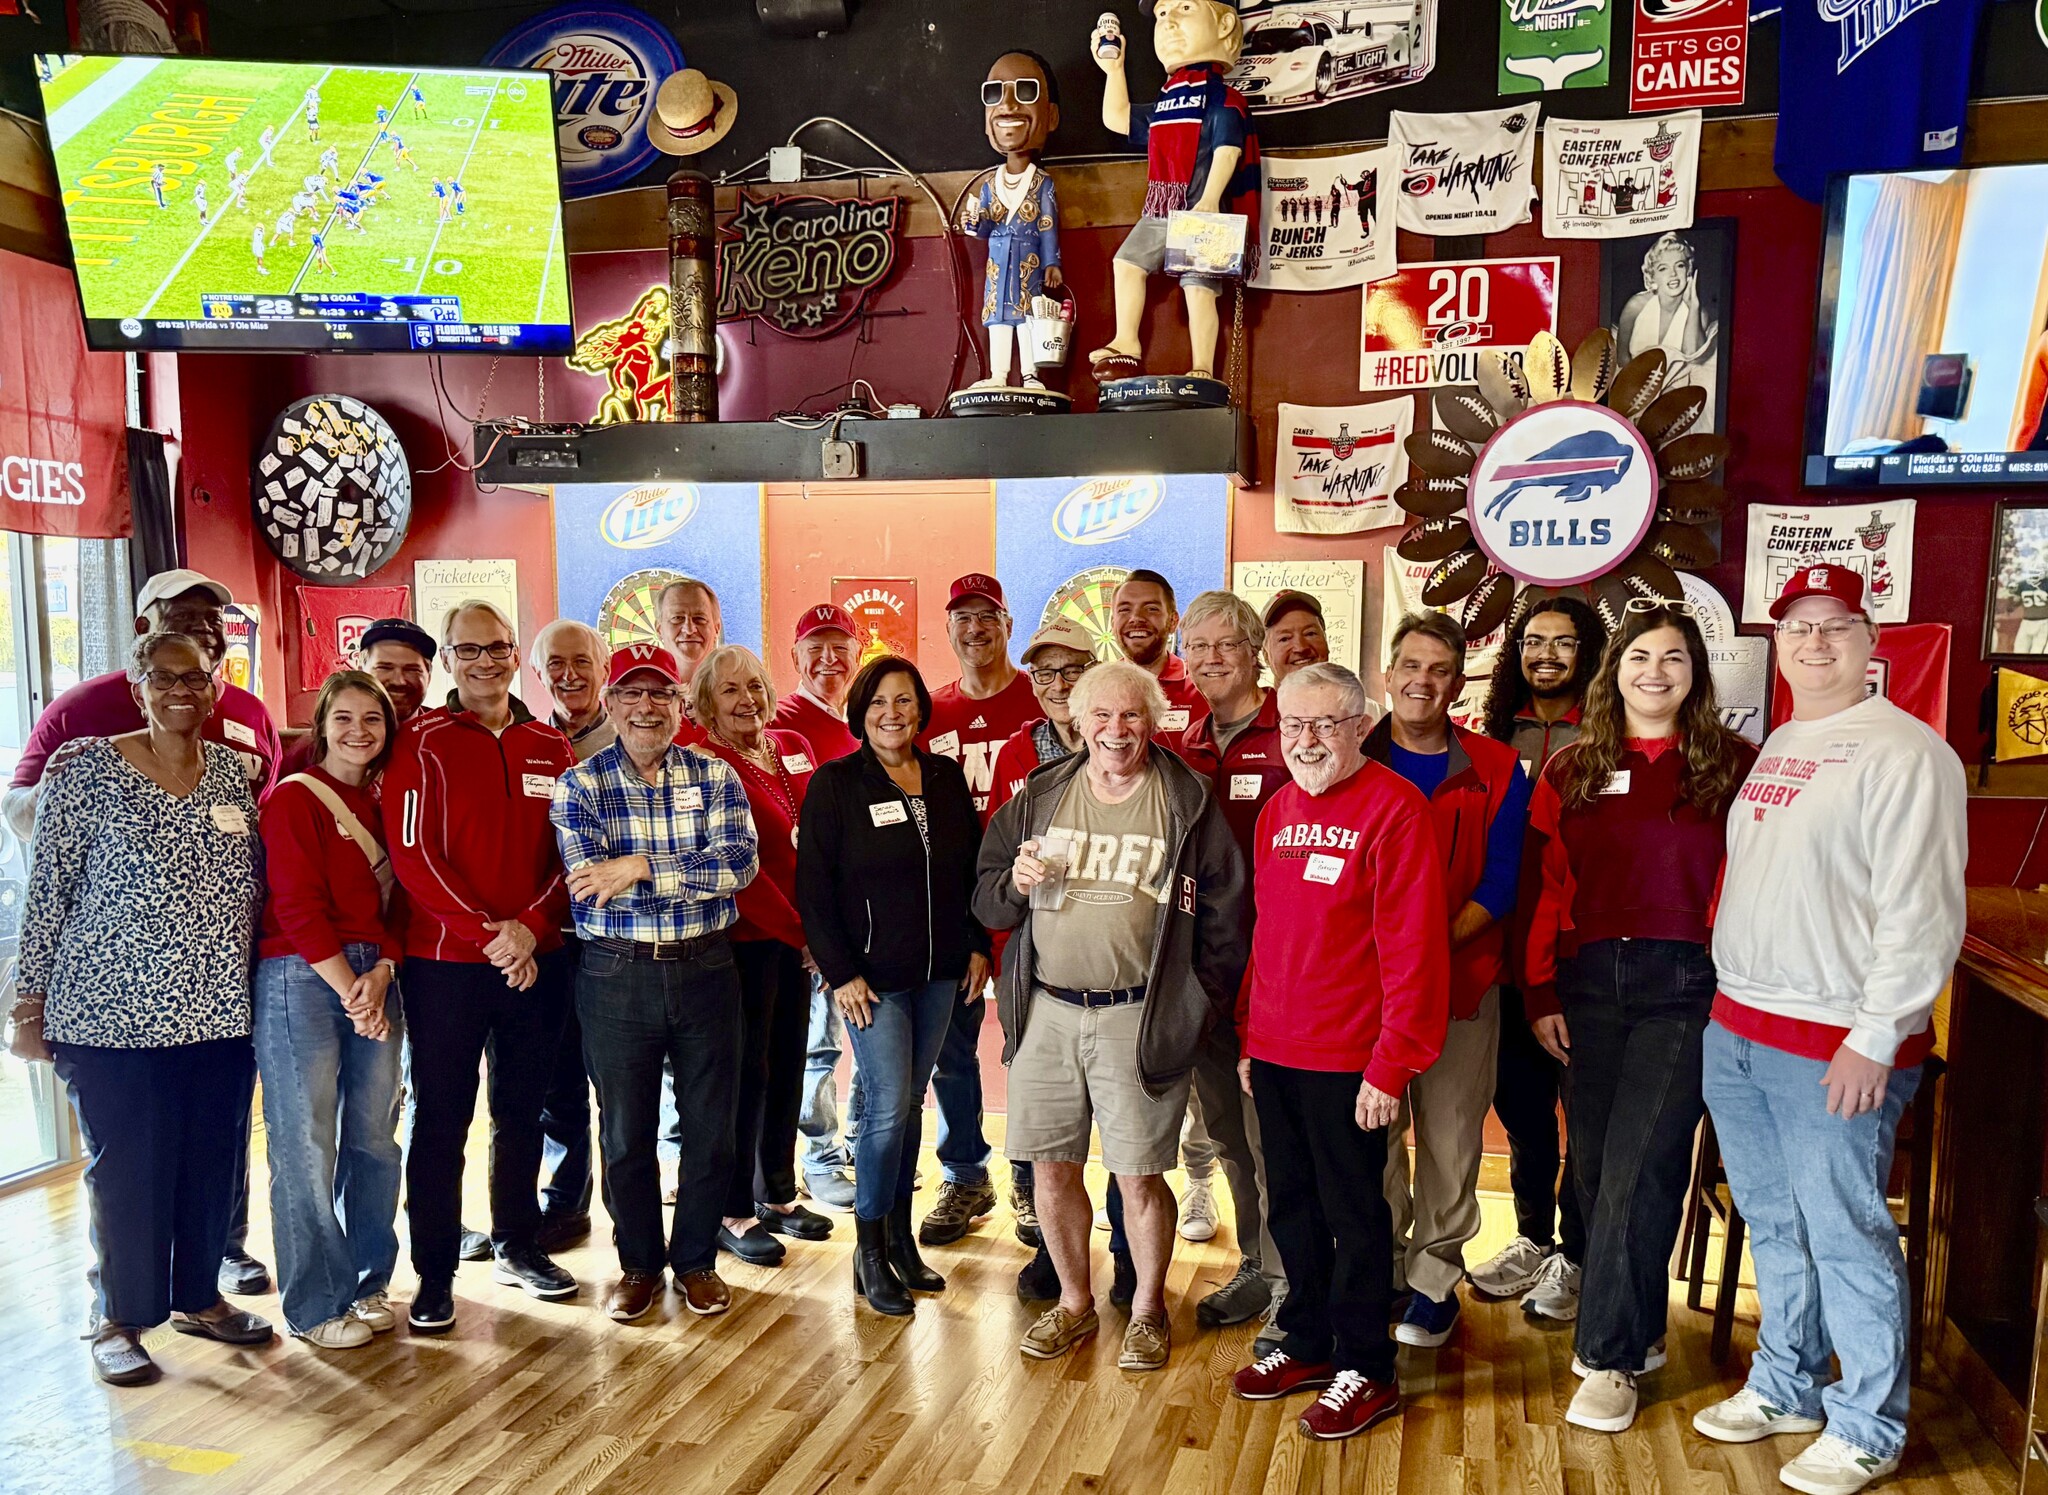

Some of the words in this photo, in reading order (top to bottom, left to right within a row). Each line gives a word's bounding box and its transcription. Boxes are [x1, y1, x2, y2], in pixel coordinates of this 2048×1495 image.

[1258, 20, 1299, 29] JAGUAR
[1535, 12, 1577, 31] NIGHT
[1638, 39, 1698, 59] LET'S
[1706, 35, 1741, 53] GO
[556, 43, 633, 69] Miller
[1357, 50, 1385, 68] LIGHT
[1240, 66, 1256, 76] 2
[1636, 55, 1741, 93] CANES
[555, 73, 649, 116] ite
[1155, 94, 1202, 113] BILLS
[1500, 116, 1528, 128] NHL
[1407, 141, 1452, 167] TAKE
[1562, 139, 1622, 152] EASTERN
[1559, 150, 1644, 166] CONFERENCE
[1438, 150, 1524, 205] WARNING
[772, 204, 893, 244] Carolina
[1425, 213, 1452, 221] OPENING
[1454, 211, 1473, 219] NIGHT
[1475, 210, 1497, 218] 10.4.18
[1271, 226, 1327, 245] BUNCH
[1269, 244, 1284, 257] OF
[1286, 245, 1325, 259] JERKS
[716, 230, 889, 316] Keno
[332, 294, 361, 302] GOAL
[1427, 267, 1490, 325] 20
[256, 300, 294, 315] 28
[318, 308, 346, 316] 4:33
[380, 302, 399, 317] 3
[430, 307, 457, 322] Pitt
[123, 321, 140, 331] abc
[190, 321, 218, 330] Florida
[236, 322, 249, 330] Ole
[249, 322, 269, 331] Miss
[435, 325, 470, 336] FLORIDA
[483, 325, 499, 336] OLE
[499, 325, 521, 337] MISS
[1441, 341, 1453, 350] EST
[1456, 336, 1471, 347] 1997
[960, 397, 971, 405] LA
[970, 396, 989, 405] VIDA
[1013, 396, 1035, 404] FINA
[1107, 388, 1123, 399] Find
[1124, 388, 1143, 400] your
[1145, 385, 1173, 396] beach.
[1293, 427, 1314, 436] CANES
[1297, 451, 1333, 474] TAKE
[1834, 457, 1876, 470] ESPN
[1883, 456, 1900, 465] SEC
[1913, 454, 1946, 464] Florida
[1948, 456, 1958, 464] vs
[1960, 455, 1966, 463] 7
[1966, 454, 1983, 464] Ole
[1984, 454, 2006, 463] Miss
[1913, 465, 1934, 473] MISS
[1982, 463, 2001, 473] 52.5
[2008, 463, 2033, 472] MISS:
[1091, 479, 1134, 497] Miller
[1322, 463, 1390, 508] WARNING
[630, 487, 671, 505] Miller
[620, 497, 684, 543] Lite
[1074, 488, 1149, 538] Lite
[1509, 518, 1611, 547] BILLS
[1770, 525, 1833, 538] EASTERN
[1767, 538, 1855, 553] CONFERENCE
[423, 567, 494, 585] Cricketeer
[1243, 570, 1331, 588] Cricketeer
[842, 588, 905, 616] FIREBALL
[815, 607, 835, 620] W
[1697, 605, 1715, 642] GAME
[628, 645, 657, 661] W
[416, 715, 445, 728] Columbia
[1780, 757, 1818, 781] COLLEGE
[1737, 782, 1802, 808] RUGBY
[1178, 873, 1197, 917] H
